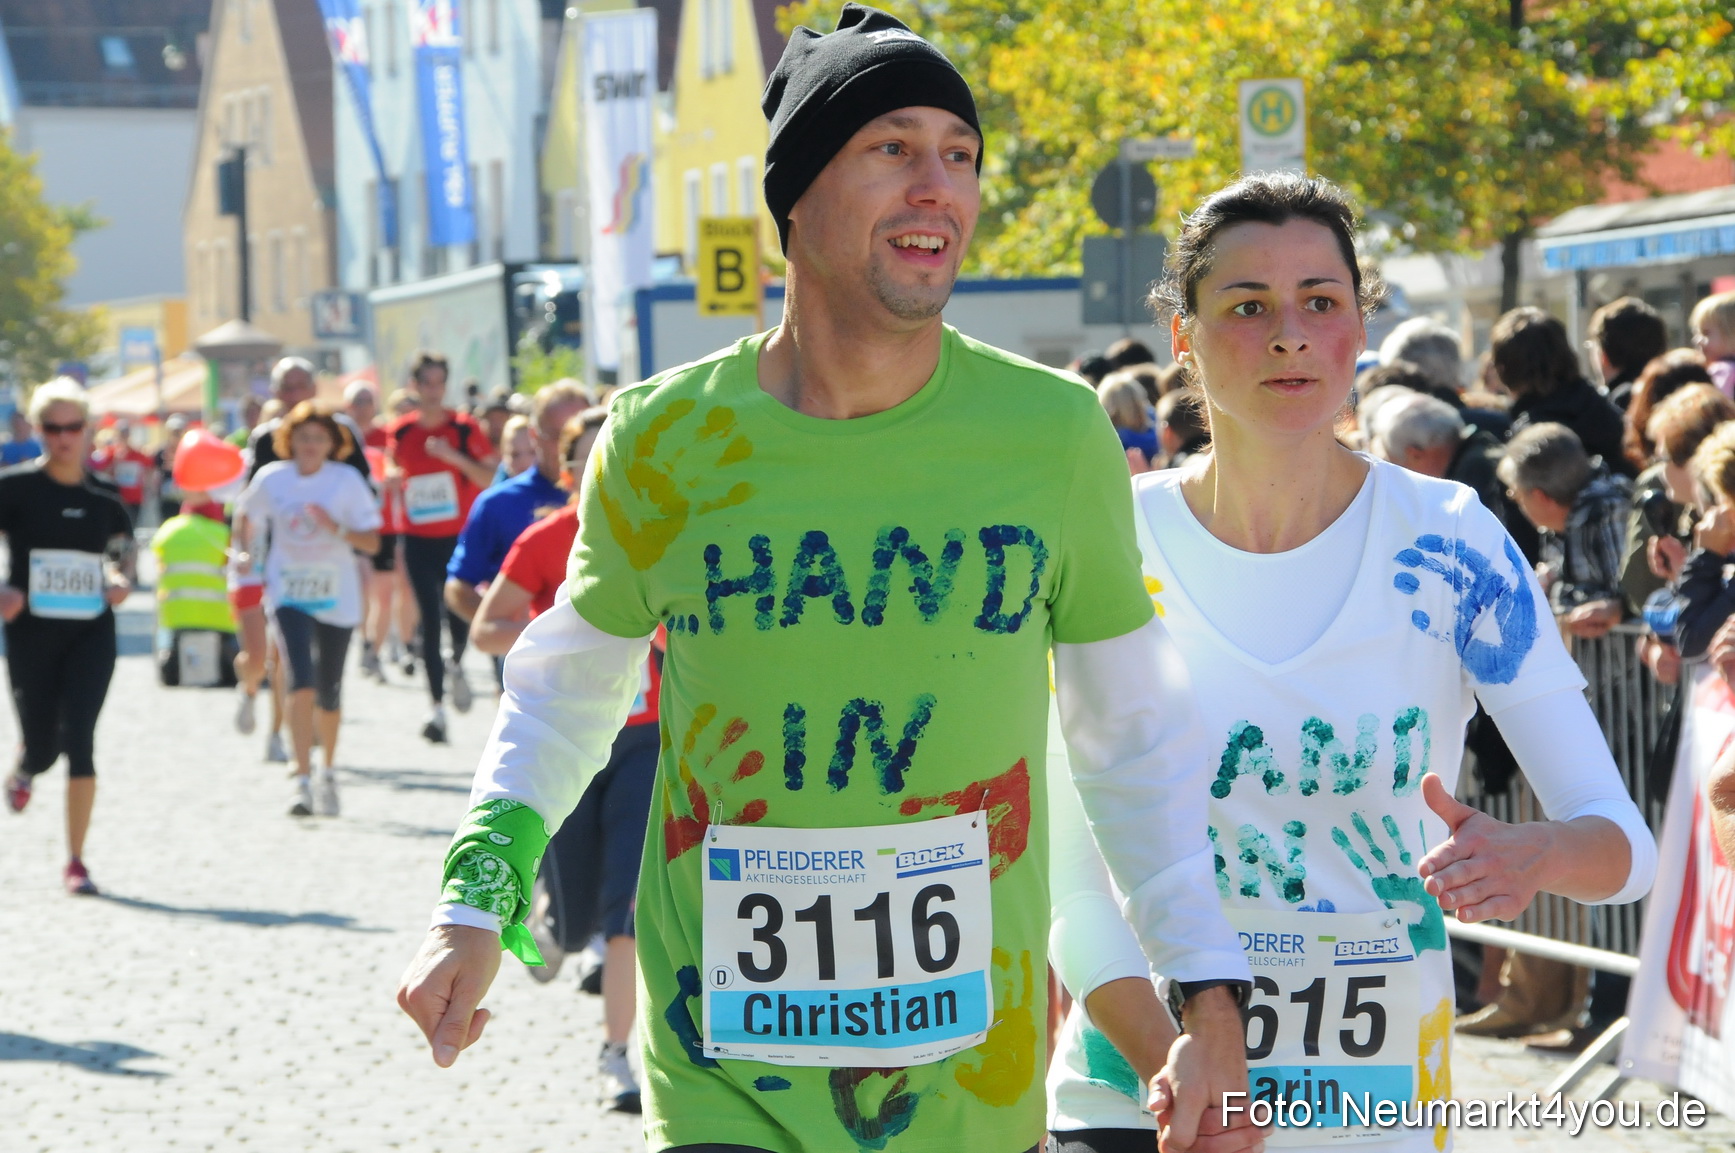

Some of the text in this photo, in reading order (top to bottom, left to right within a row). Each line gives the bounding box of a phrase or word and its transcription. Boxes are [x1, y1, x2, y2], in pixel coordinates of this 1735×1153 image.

[715, 248, 745, 293] B
[40, 567, 94, 594] 3569
[783, 693, 937, 796] IN
[744, 849, 866, 871] PFLEIDERER
[896, 843, 964, 868] BOCK
[745, 873, 867, 885] AKTIENGESELLSCHAFT
[737, 883, 960, 982] 3116
[1335, 938, 1399, 956] BOCK
[716, 970, 727, 985] D
[743, 988, 958, 1037] Christian
[1246, 975, 1387, 1060] 615
[1248, 1068, 1341, 1114] arin
